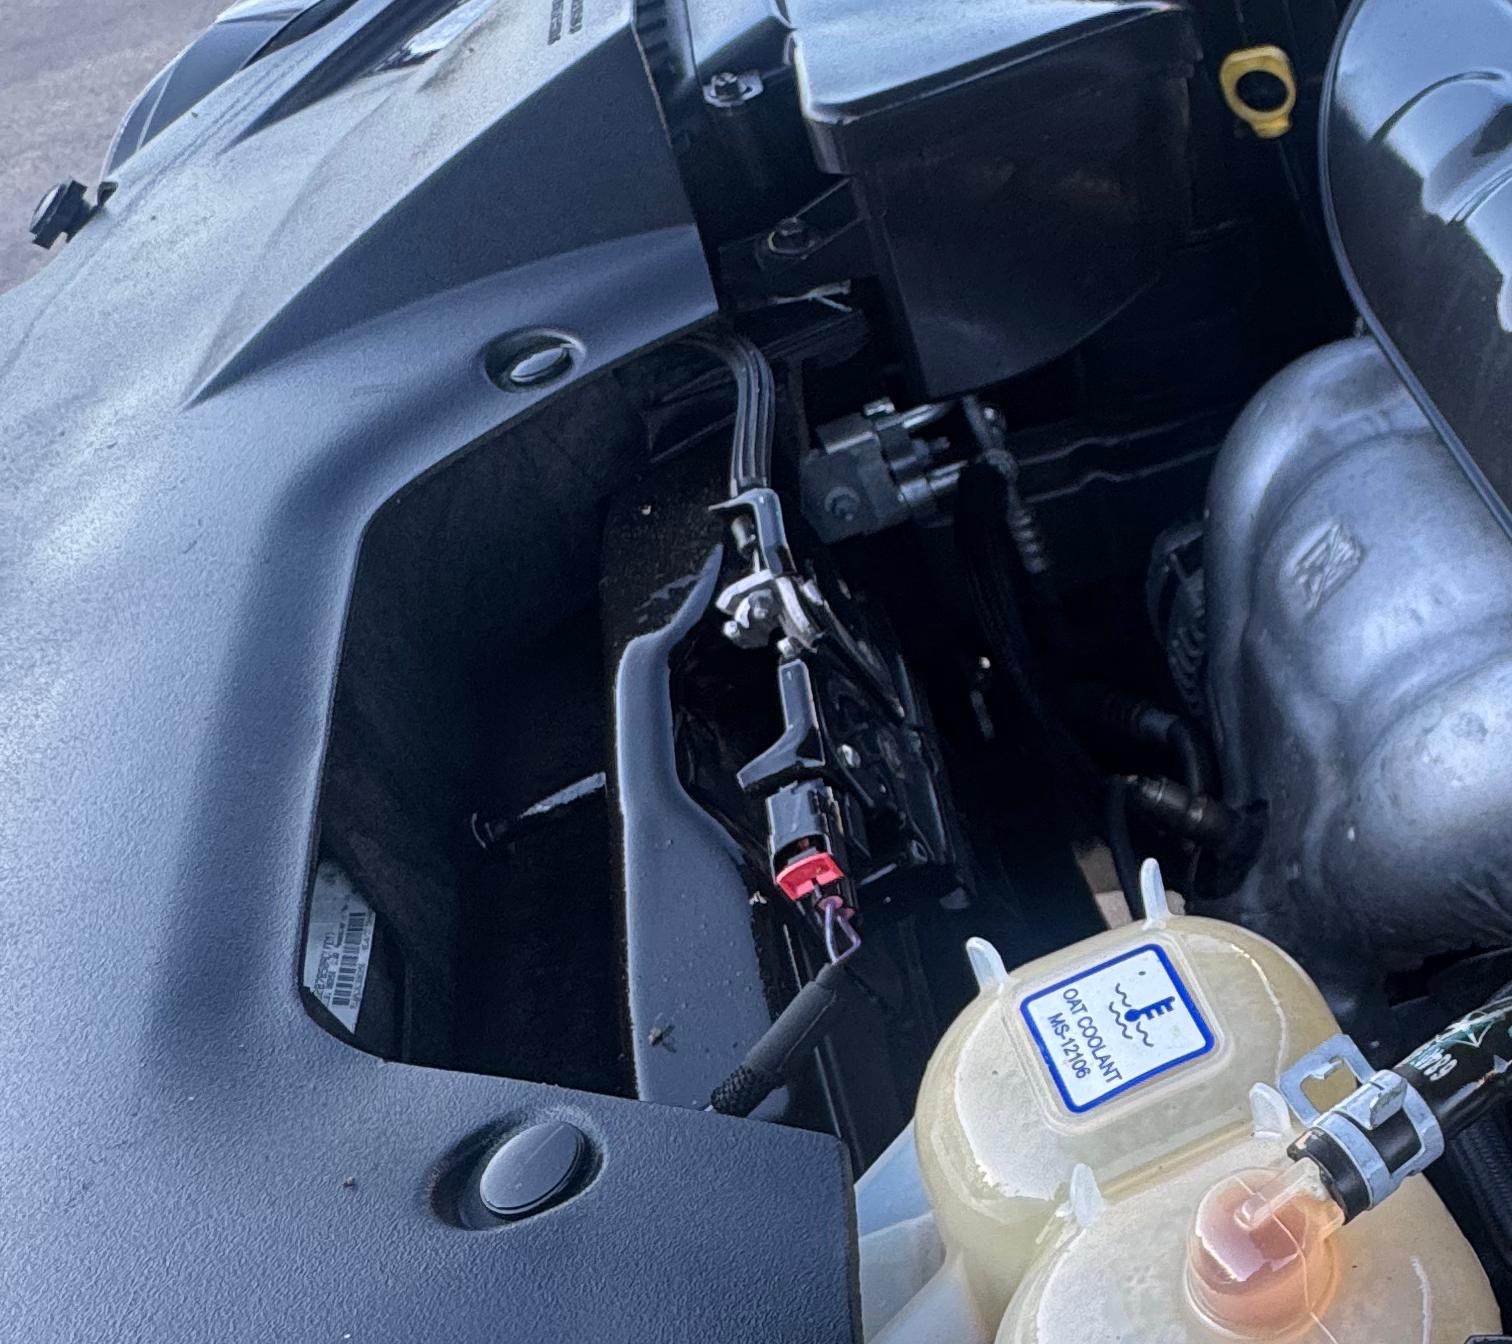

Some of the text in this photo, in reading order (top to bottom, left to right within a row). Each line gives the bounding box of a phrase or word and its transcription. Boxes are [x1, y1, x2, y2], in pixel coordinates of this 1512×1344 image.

[1063, 988, 1088, 1014] OAT
[1048, 1012, 1091, 1078] MS-12106
[1077, 1016, 1123, 1083] COOLANT
